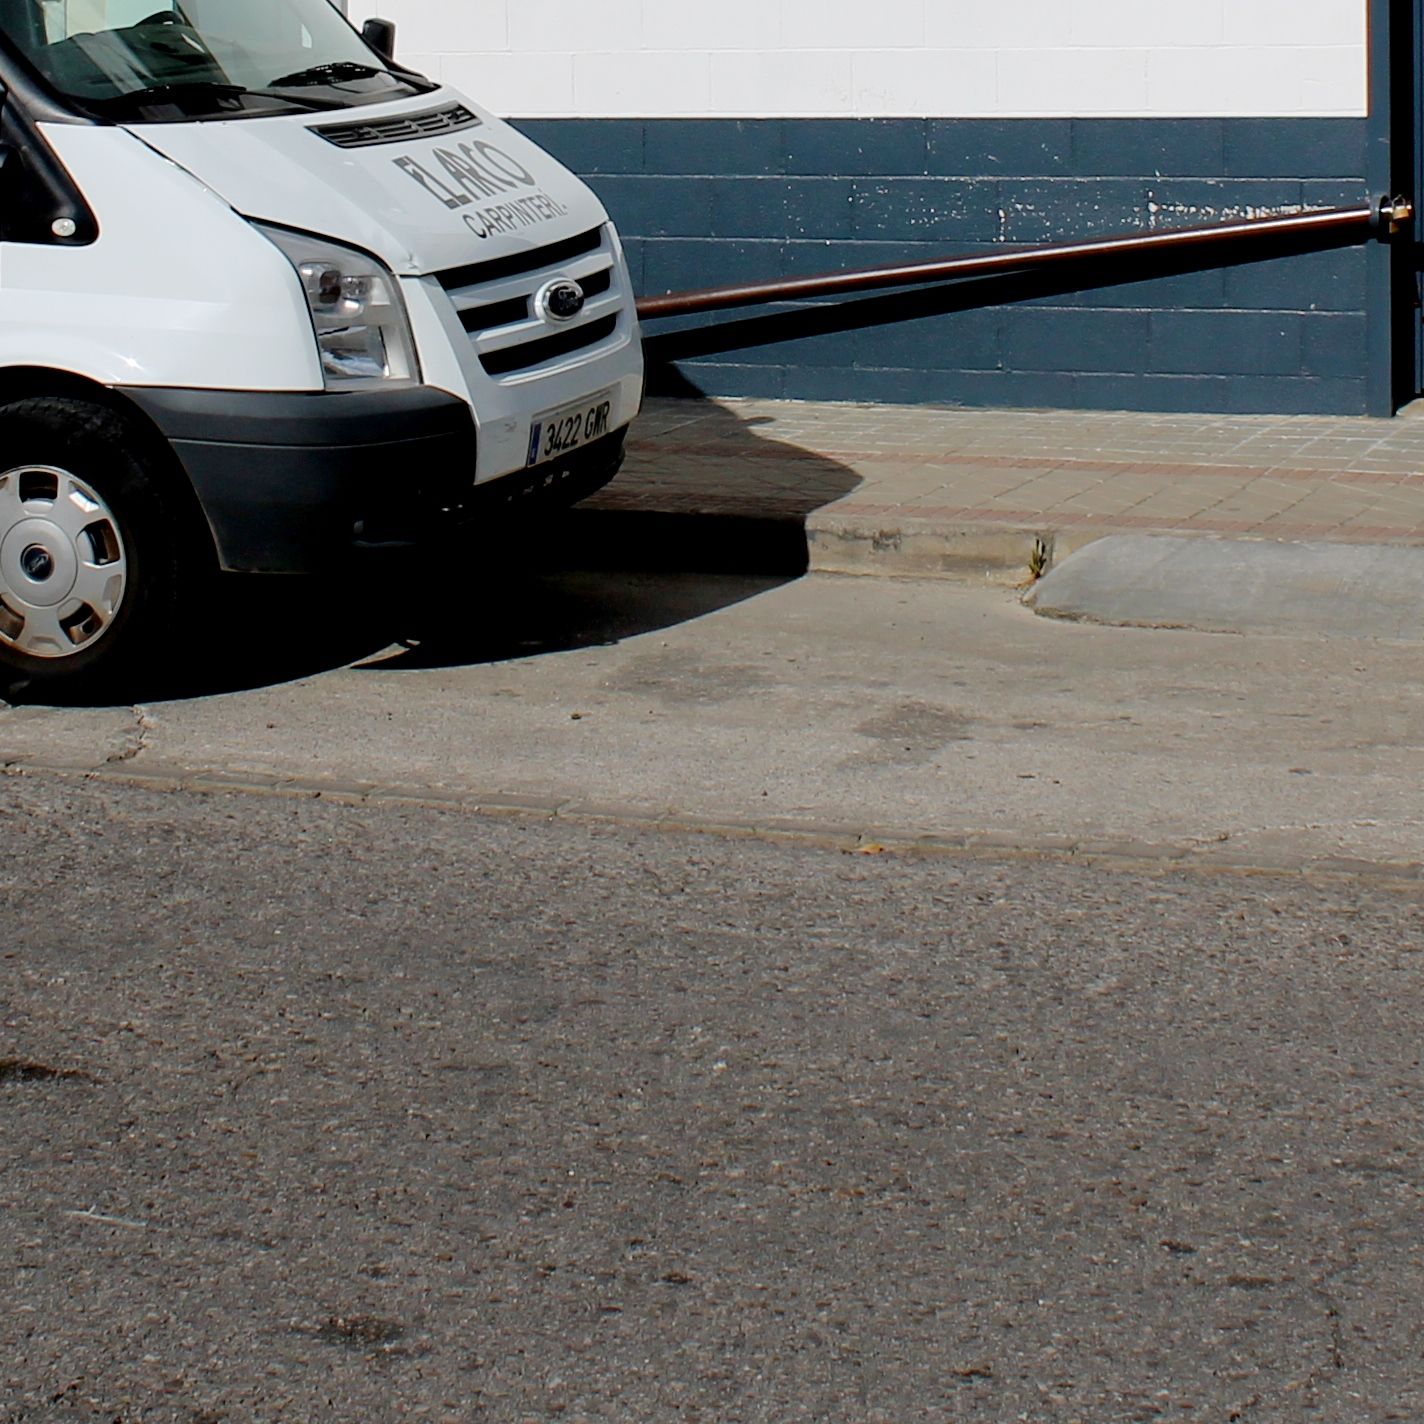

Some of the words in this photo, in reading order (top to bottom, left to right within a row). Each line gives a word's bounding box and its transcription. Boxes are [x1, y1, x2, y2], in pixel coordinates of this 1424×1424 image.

[391, 155, 473, 210] EL
[432, 140, 536, 200] ARCO
[543, 413, 582, 456] 3422
